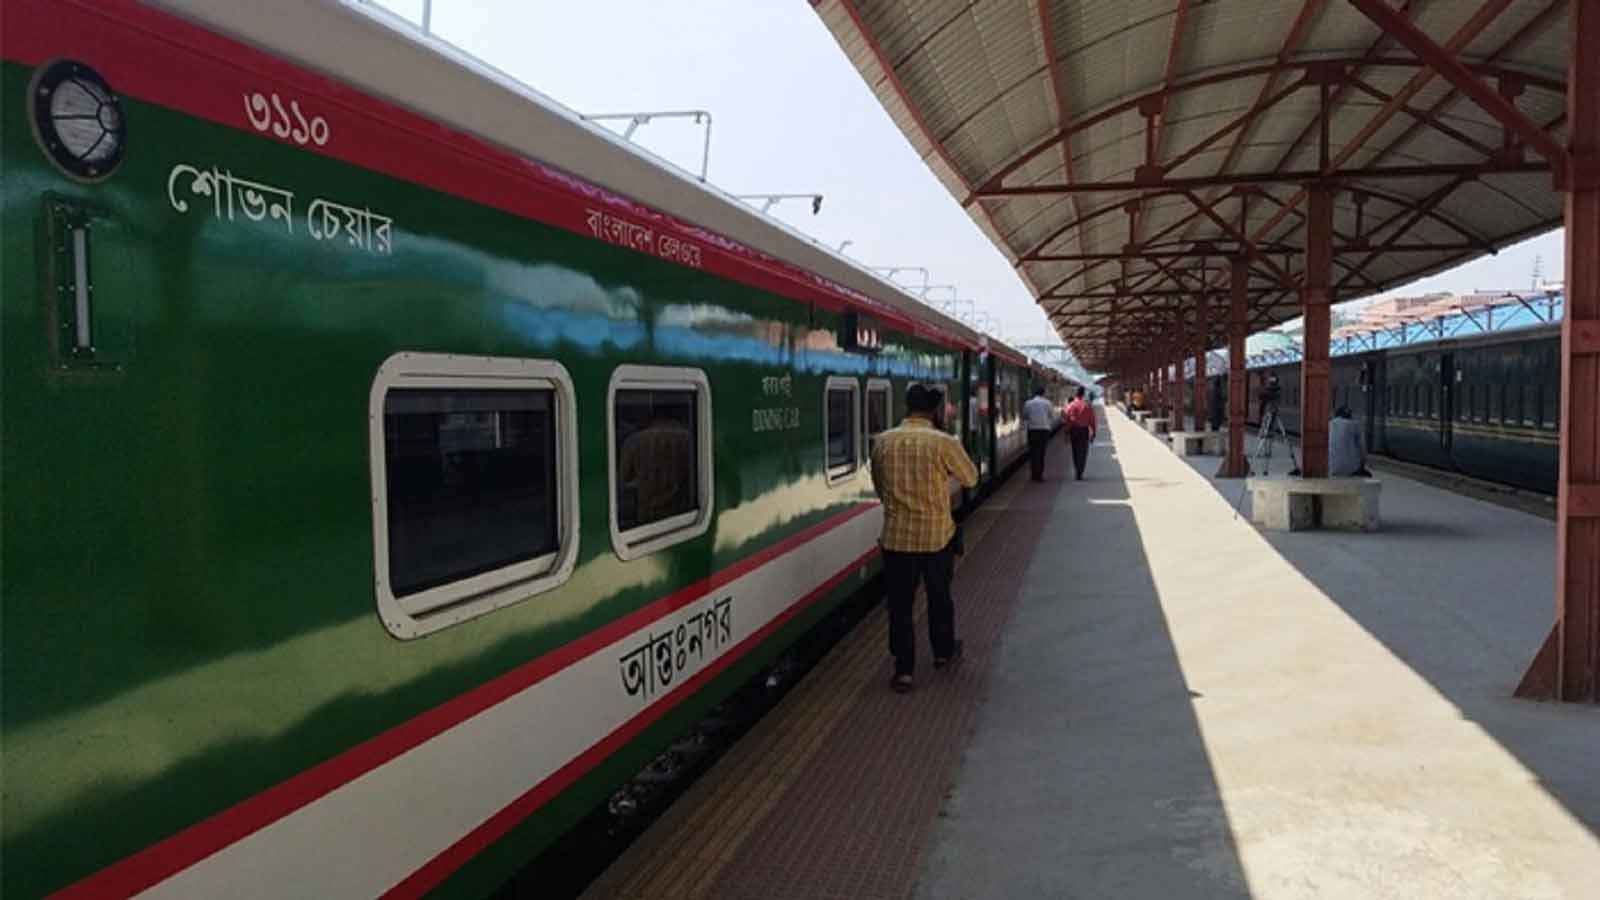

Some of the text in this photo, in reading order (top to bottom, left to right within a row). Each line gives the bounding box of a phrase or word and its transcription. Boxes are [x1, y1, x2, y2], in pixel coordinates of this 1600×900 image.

[243, 92, 329, 145] ৩১১০
[168, 163, 392, 255] শোভন চেয়ার
[618, 595, 733, 701] আন্তঃনগর
